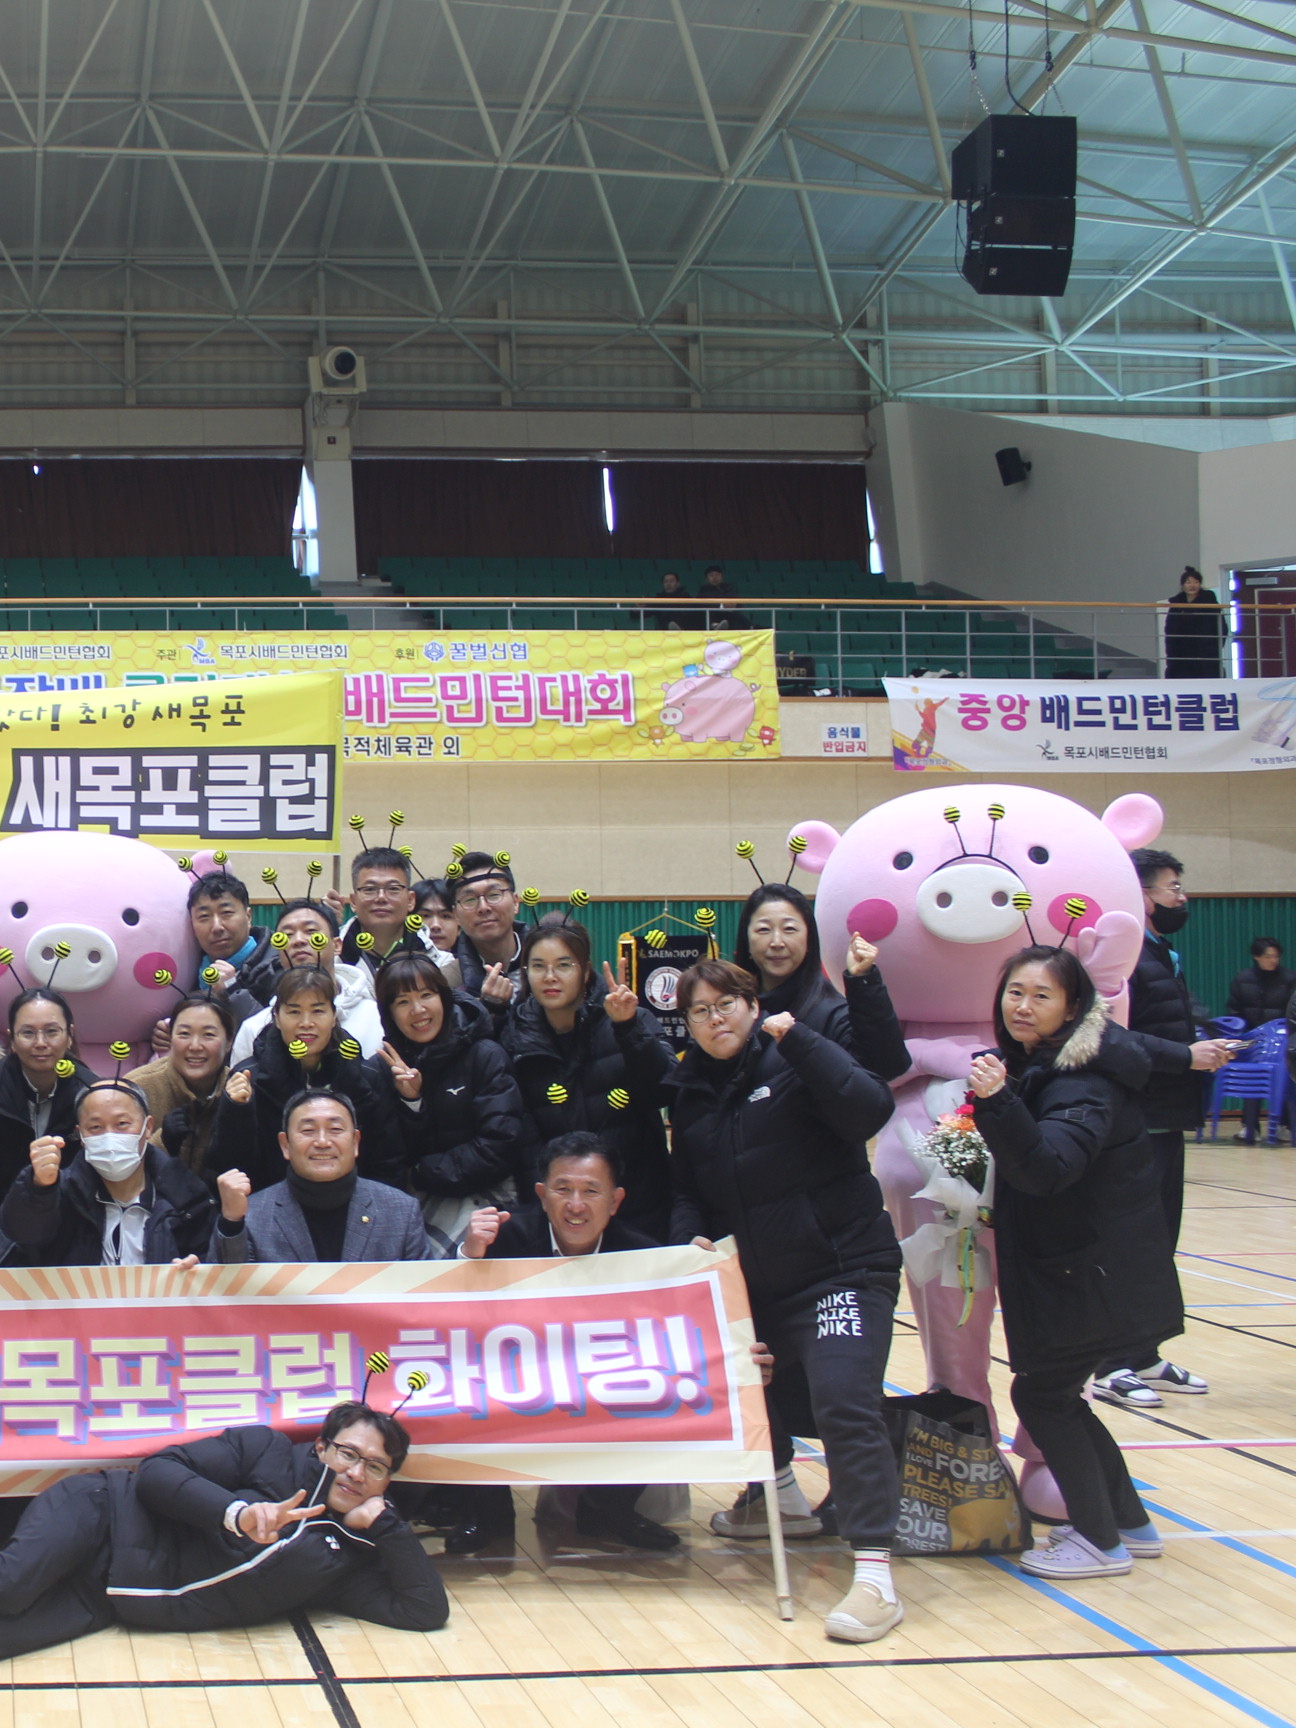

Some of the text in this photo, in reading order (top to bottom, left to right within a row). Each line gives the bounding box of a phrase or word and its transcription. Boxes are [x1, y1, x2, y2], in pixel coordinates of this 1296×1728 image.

[156, 648, 176, 661] 주관
[220, 644, 348, 660] 목포시배드민턴협회
[395, 642, 527, 661] 후원 꿀벌신협
[343, 673, 633, 724] 배드민턴대회
[79, 699, 141, 728] 최강
[152, 695, 245, 732] 새목포
[957, 692, 1241, 731] 중앙 배드민턴클럽
[827, 727, 861, 739] 음식물
[442, 736, 461, 757] 외
[823, 741, 866, 753] 반입금지
[1064, 746, 1168, 760] 목포시배드민턴협회
[8, 752, 330, 832] 새목포클럽
[816, 1291, 858, 1312] NIKE
[816, 1307, 860, 1324] NIKE
[817, 1320, 862, 1339] NIKE
[388, 1314, 712, 1418] 화이팅!
[907, 1443, 933, 1458] AND
[930, 1435, 954, 1454] BIG
[910, 1454, 933, 1468] LOVE
[935, 1451, 1005, 1482] FORE
[904, 1463, 979, 1498] PLEASE
[903, 1482, 953, 1508] TREES!
[900, 1498, 946, 1521] SAVE
[895, 1514, 948, 1541] OUR
